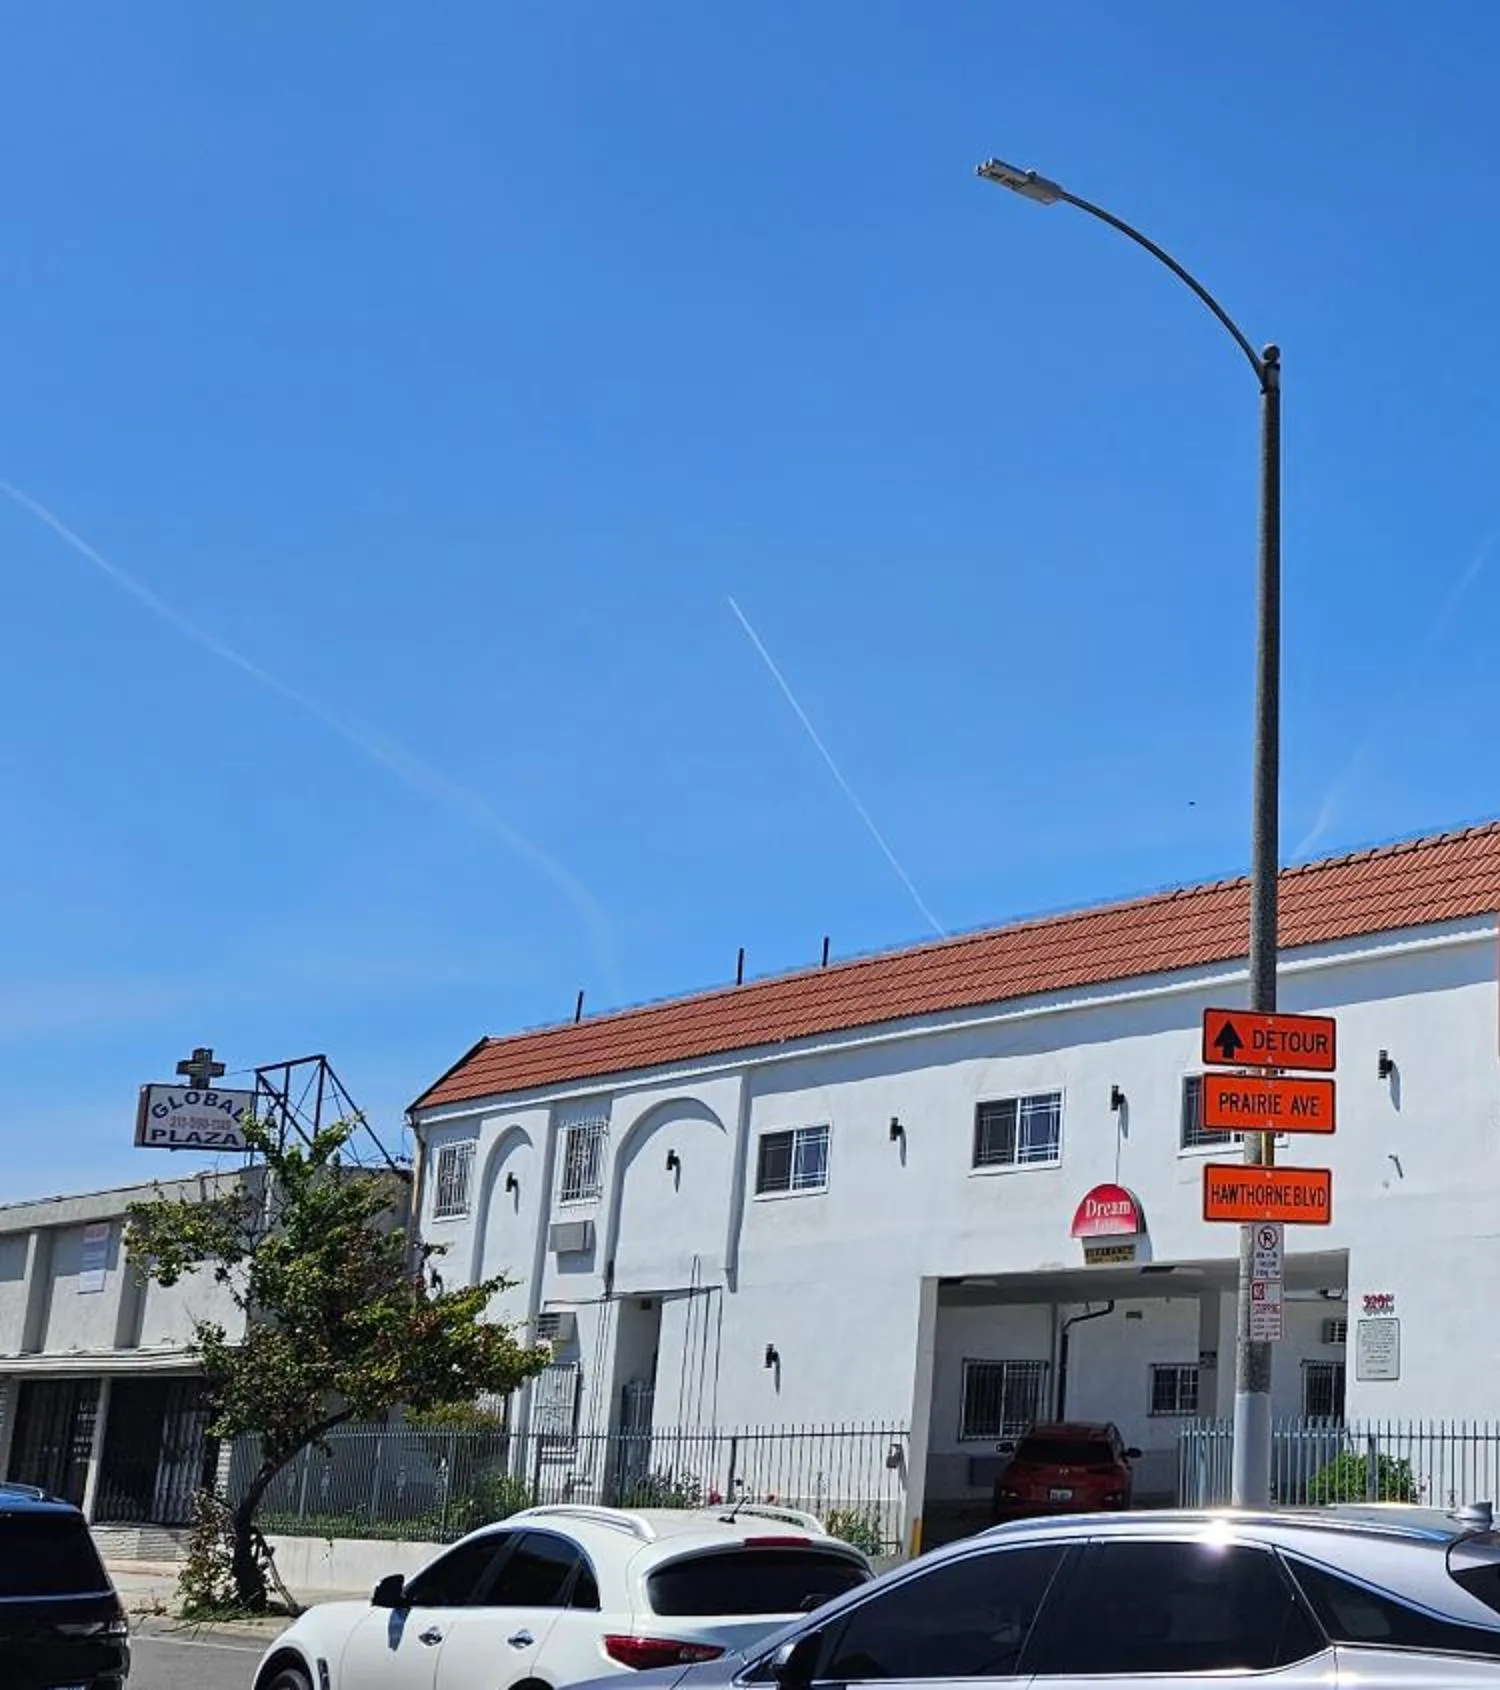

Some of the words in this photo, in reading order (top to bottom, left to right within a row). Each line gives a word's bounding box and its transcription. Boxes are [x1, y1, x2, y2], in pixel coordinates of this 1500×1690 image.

[1252, 1029, 1329, 1054] DETOUR
[151, 1091, 244, 1123] GLOBAL
[1219, 1092, 1283, 1115] PRAIRIE
[1290, 1095, 1320, 1116] AVE
[150, 1129, 239, 1146] PLAZA
[1211, 1183, 1293, 1206] HAWTHORNE
[1293, 1187, 1325, 1208] BLVD
[1085, 1199, 1131, 1218] Dream
